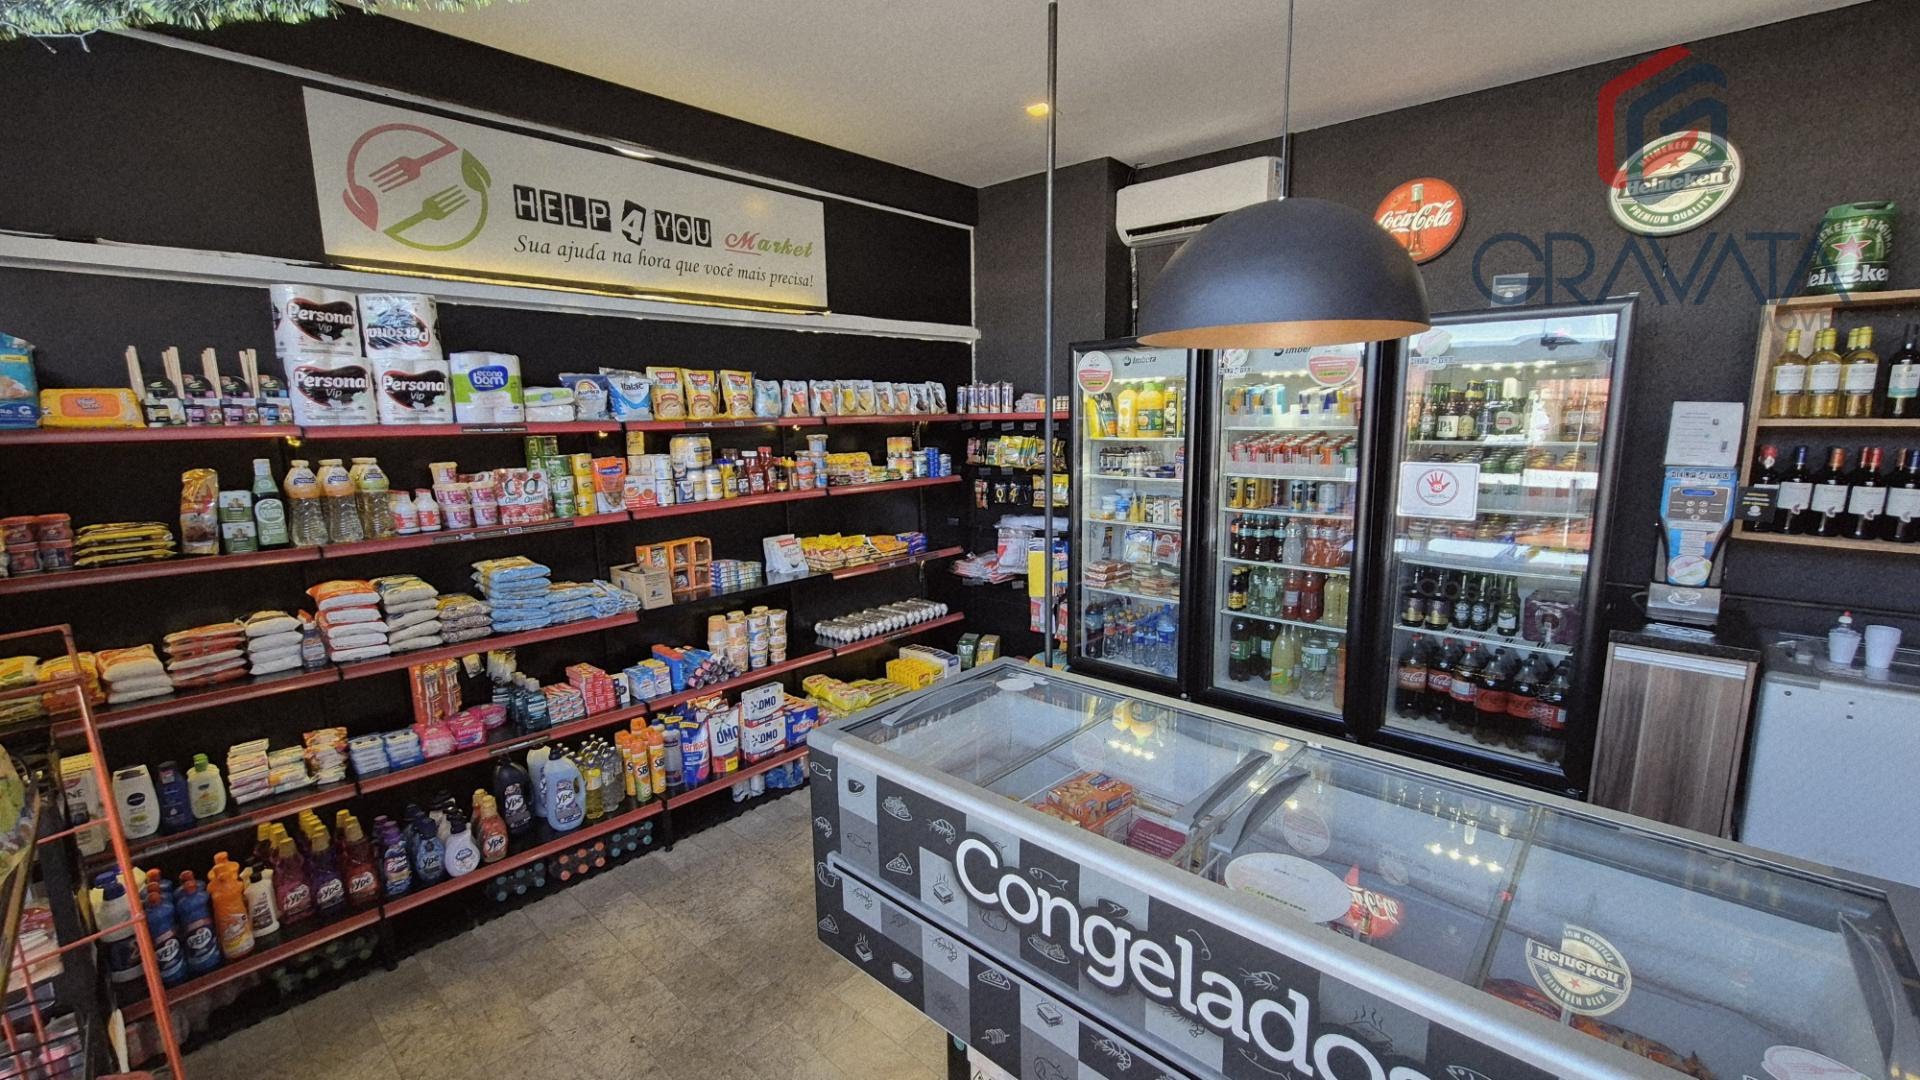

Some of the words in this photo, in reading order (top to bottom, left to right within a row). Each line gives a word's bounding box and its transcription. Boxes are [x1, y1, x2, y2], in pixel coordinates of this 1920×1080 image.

[1624, 168, 1726, 198] Heineken
[1628, 203, 1670, 225] PREMIUM
[1672, 195, 1713, 223] QUALITY
[513, 184, 612, 232] HELP
[621, 199, 647, 246] 4
[654, 209, 712, 248] YOU
[725, 231, 813, 257] Market
[514, 235, 550, 254] Sua
[557, 241, 605, 262] ajuda
[612, 252, 632, 264] na
[638, 249, 671, 269] hora
[675, 259, 700, 276] que
[704, 263, 734, 277] você
[738, 267, 767, 282] mais
[769, 272, 814, 288] precisa!
[287, 303, 356, 325] Personal
[294, 371, 369, 389] Personal
[383, 375, 447, 391] Personal
[325, 388, 343, 398] Vip
[410, 392, 425, 401] Vip
[759, 696, 777, 711] OMO
[717, 725, 739, 744] OMO
[760, 729, 778, 744] OMO
[955, 838, 1432, 1080] Congelado
